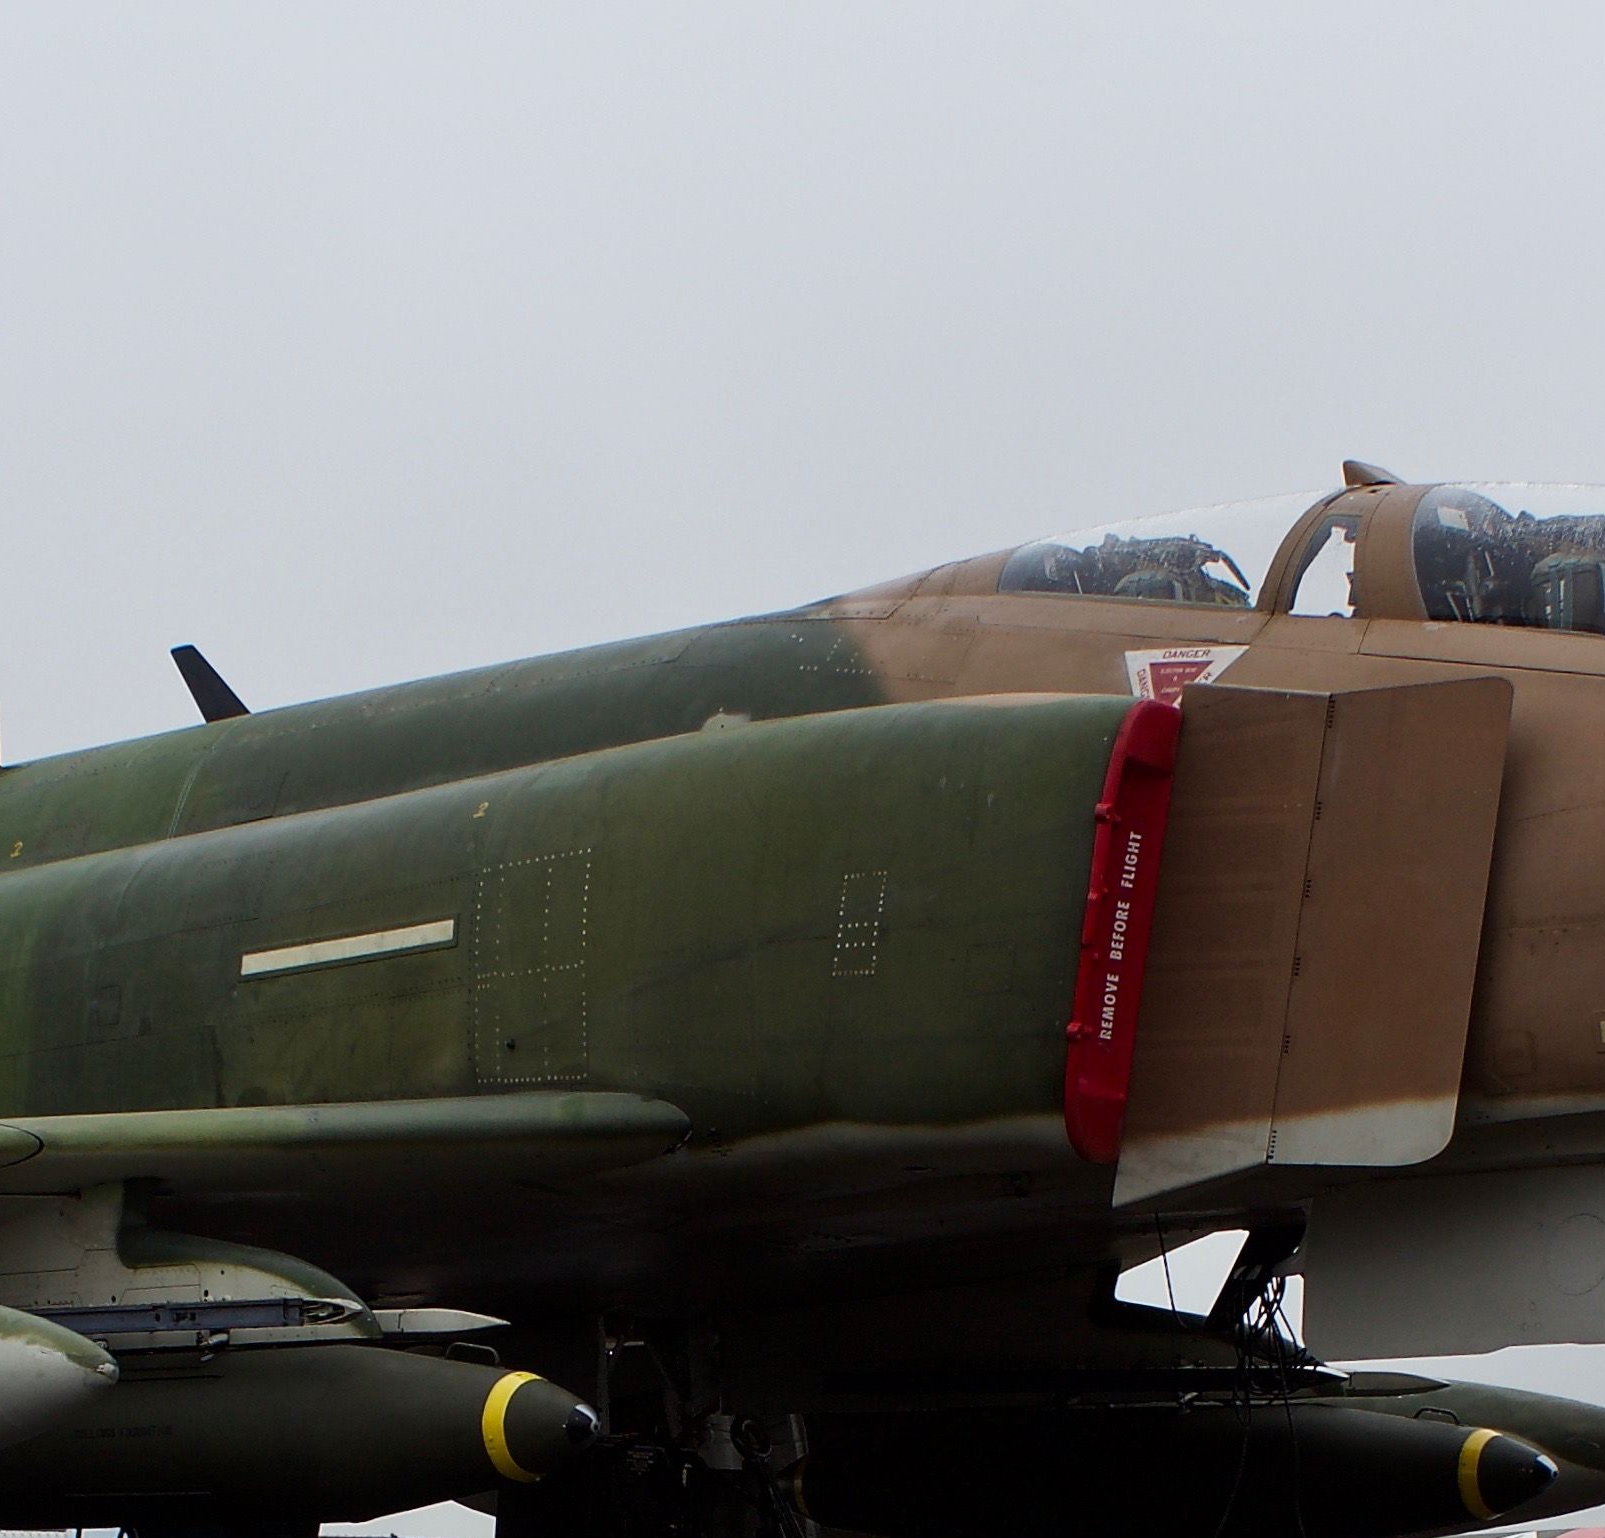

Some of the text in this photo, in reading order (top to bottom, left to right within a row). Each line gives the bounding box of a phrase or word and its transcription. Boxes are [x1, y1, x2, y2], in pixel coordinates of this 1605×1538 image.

[1163, 650, 1211, 659] DANGER
[9, 840, 24, 859] 2
[1100, 831, 1142, 1040] REMOVE BEFORE FLIGHT
